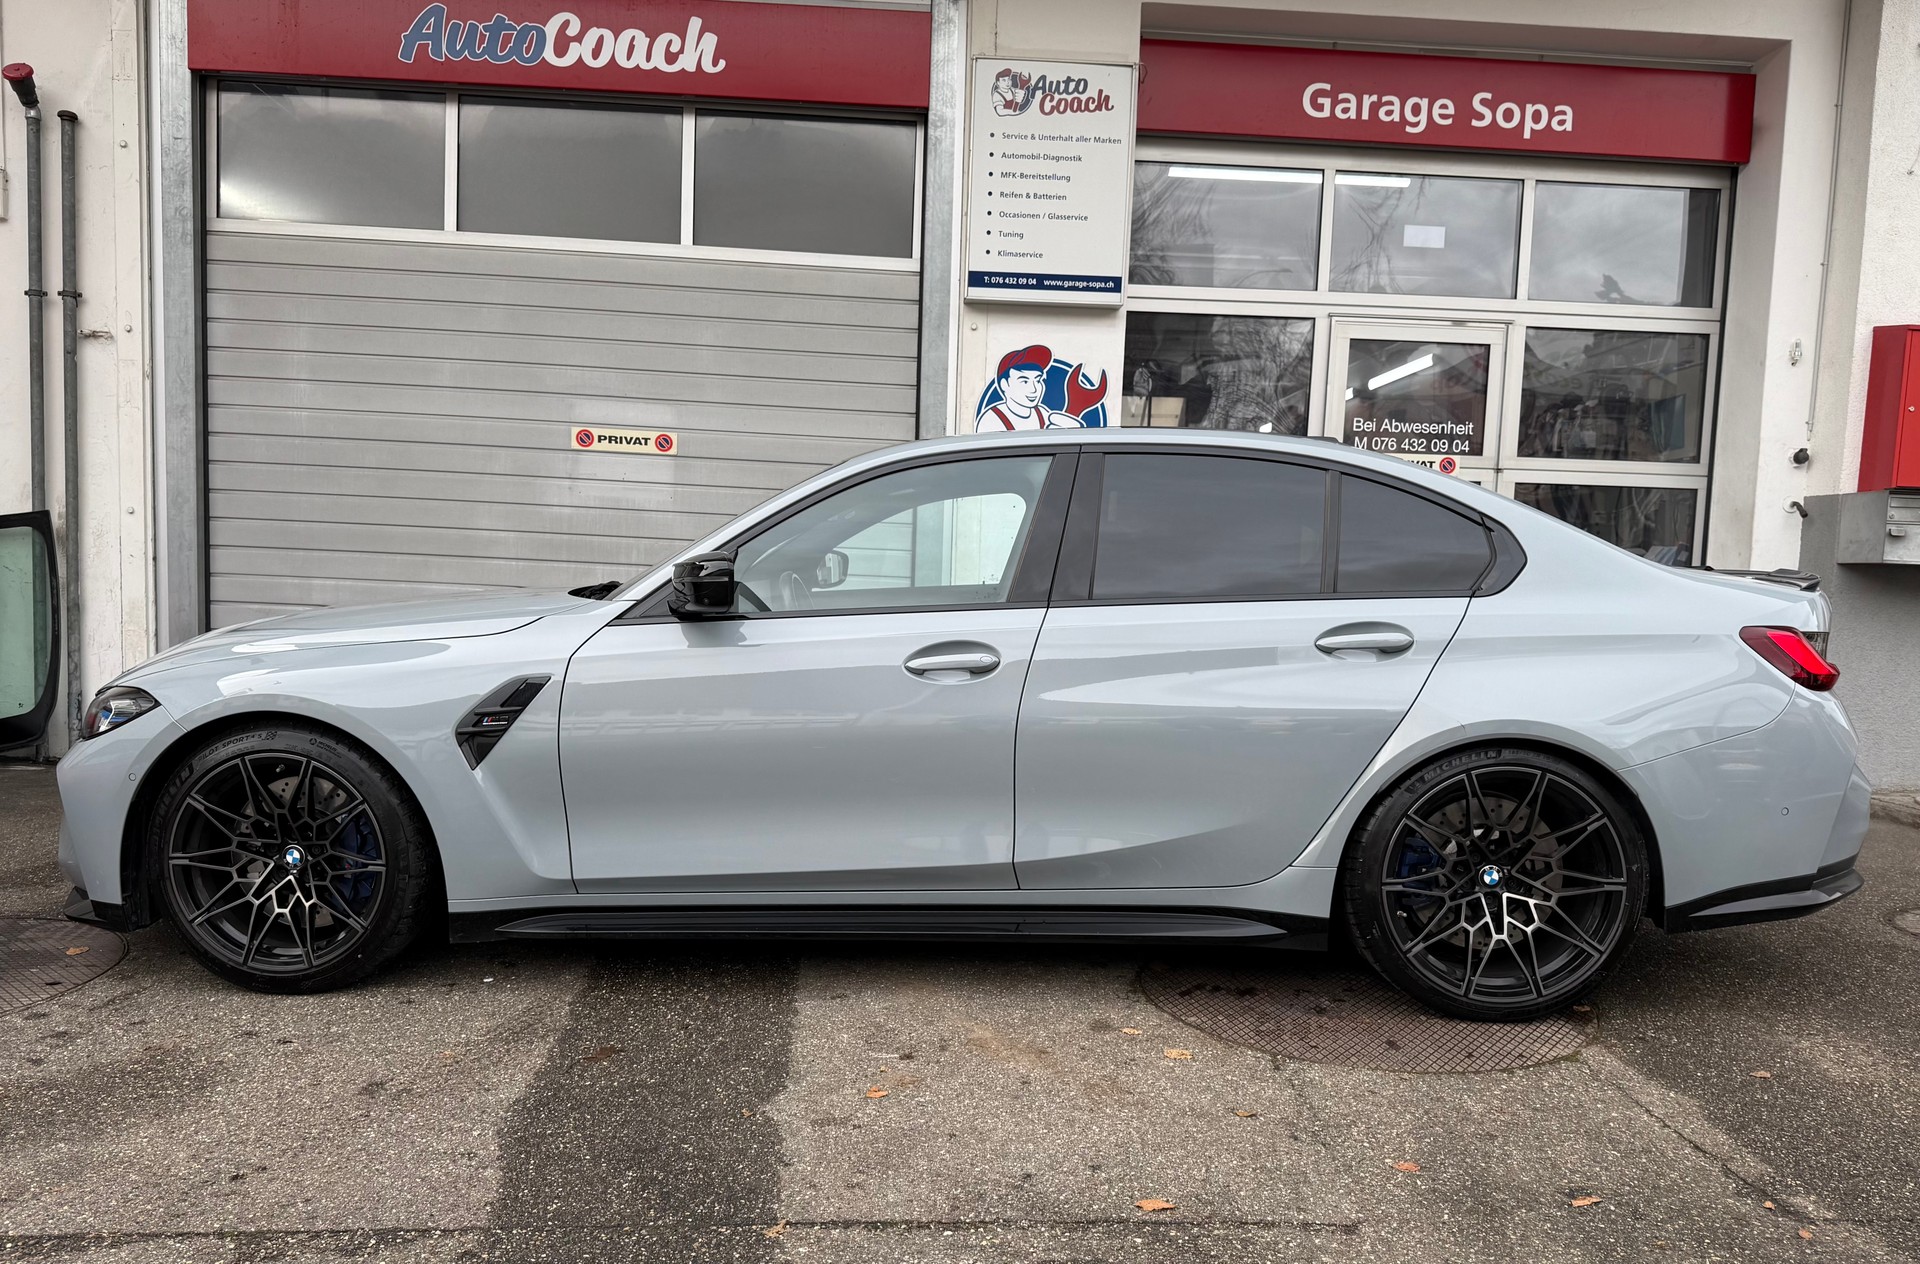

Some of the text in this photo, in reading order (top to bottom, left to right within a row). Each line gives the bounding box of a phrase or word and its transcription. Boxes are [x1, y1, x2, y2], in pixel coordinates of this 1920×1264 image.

[1030, 74, 1089, 100] Auto
[1039, 88, 1115, 116] Coach
[1302, 82, 1574, 139] Garage Sopa
[1002, 132, 1029, 141] Service
[1030, 133, 1036, 141] &
[1038, 134, 1074, 143] Unterhalt
[1093, 136, 1122, 145] Marken
[1000, 152, 1083, 163] Automobil-Diagnostik
[1000, 171, 1071, 183] MFK-Bereitstellung
[999, 191, 1067, 201] Reifen & Batterien
[998, 210, 1041, 220] Occasionen
[1047, 213, 1089, 222] Glasservice
[998, 230, 1024, 240] Tuning
[997, 250, 1044, 259] Klimaservice
[984, 276, 1115, 289] T: 076 432 09 04 www.garage-sopa.ch
[1352, 417, 1474, 436] Bei Abwesenheit
[597, 434, 651, 446] PRIVAT
[1354, 436, 1470, 453] M 076 432 09 04
[222, 734, 251, 749] SPORT
[1423, 750, 1498, 782] MICHELIN
